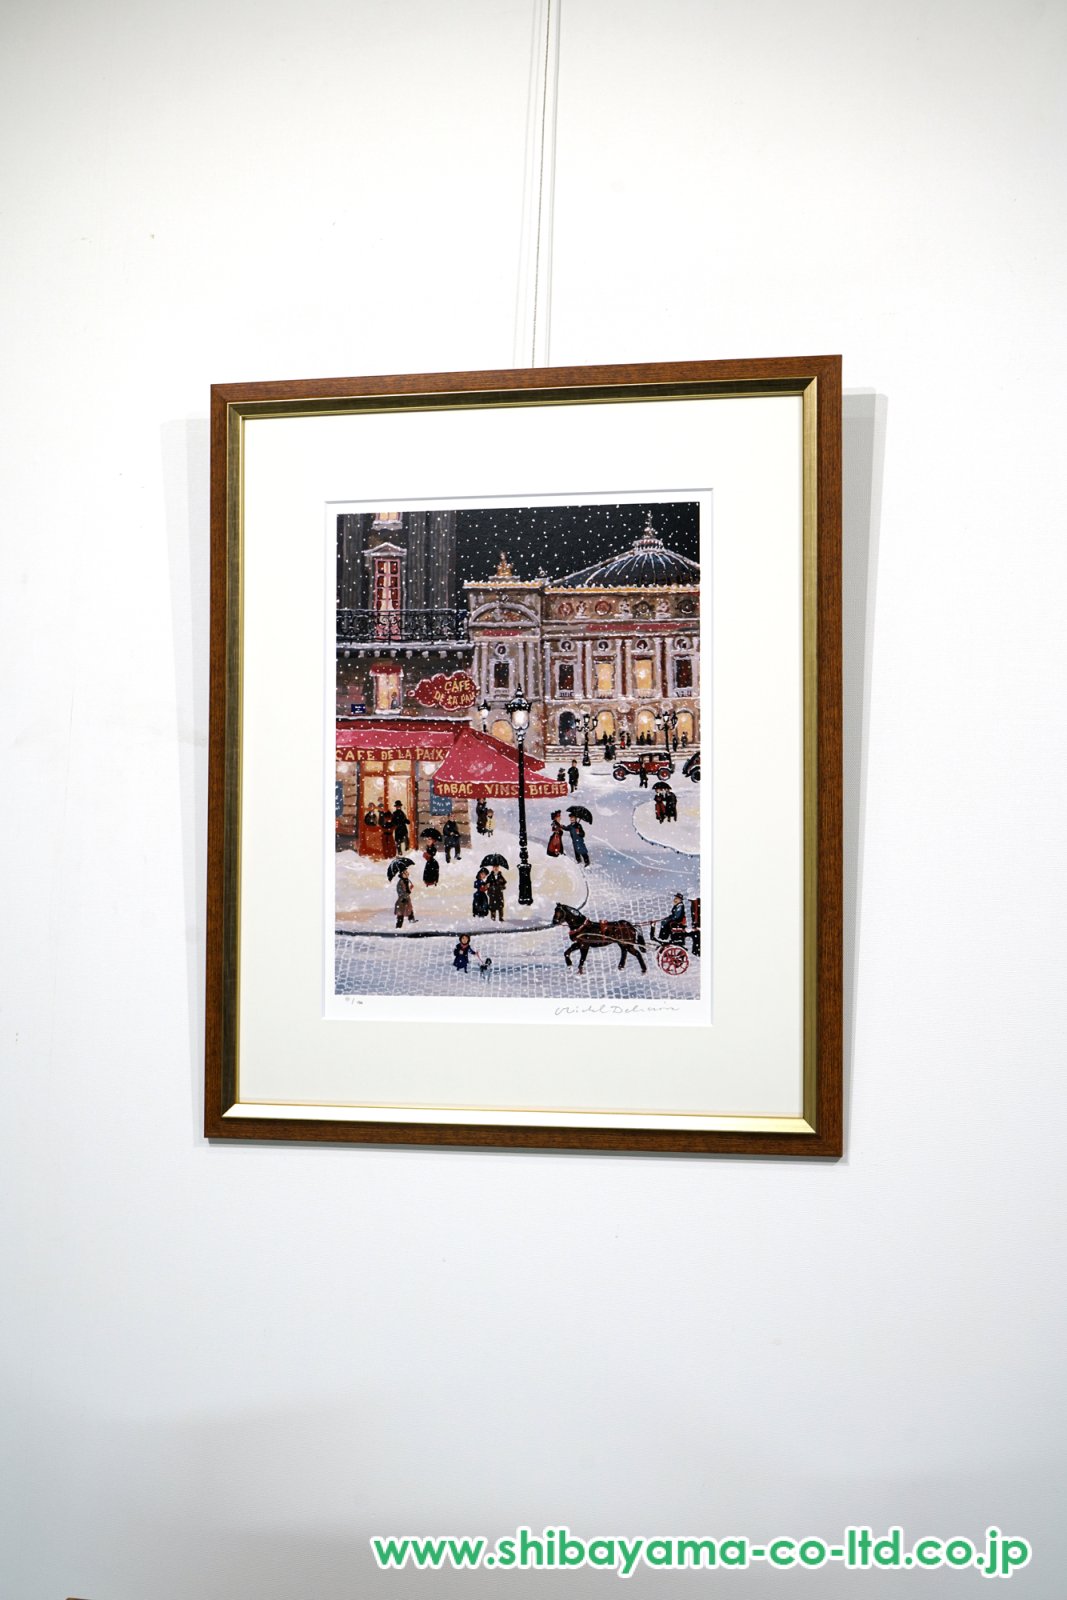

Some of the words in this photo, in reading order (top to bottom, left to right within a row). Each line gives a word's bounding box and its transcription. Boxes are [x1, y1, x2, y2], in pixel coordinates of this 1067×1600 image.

[444, 680, 471, 692] CAFE
[433, 691, 445, 702] DE
[336, 749, 375, 760] CAFE
[381, 749, 394, 760] DE
[398, 749, 412, 760] LA
[416, 747, 444, 760] PAIX
[437, 783, 474, 795] TABAC
[484, 784, 519, 796] VINS
